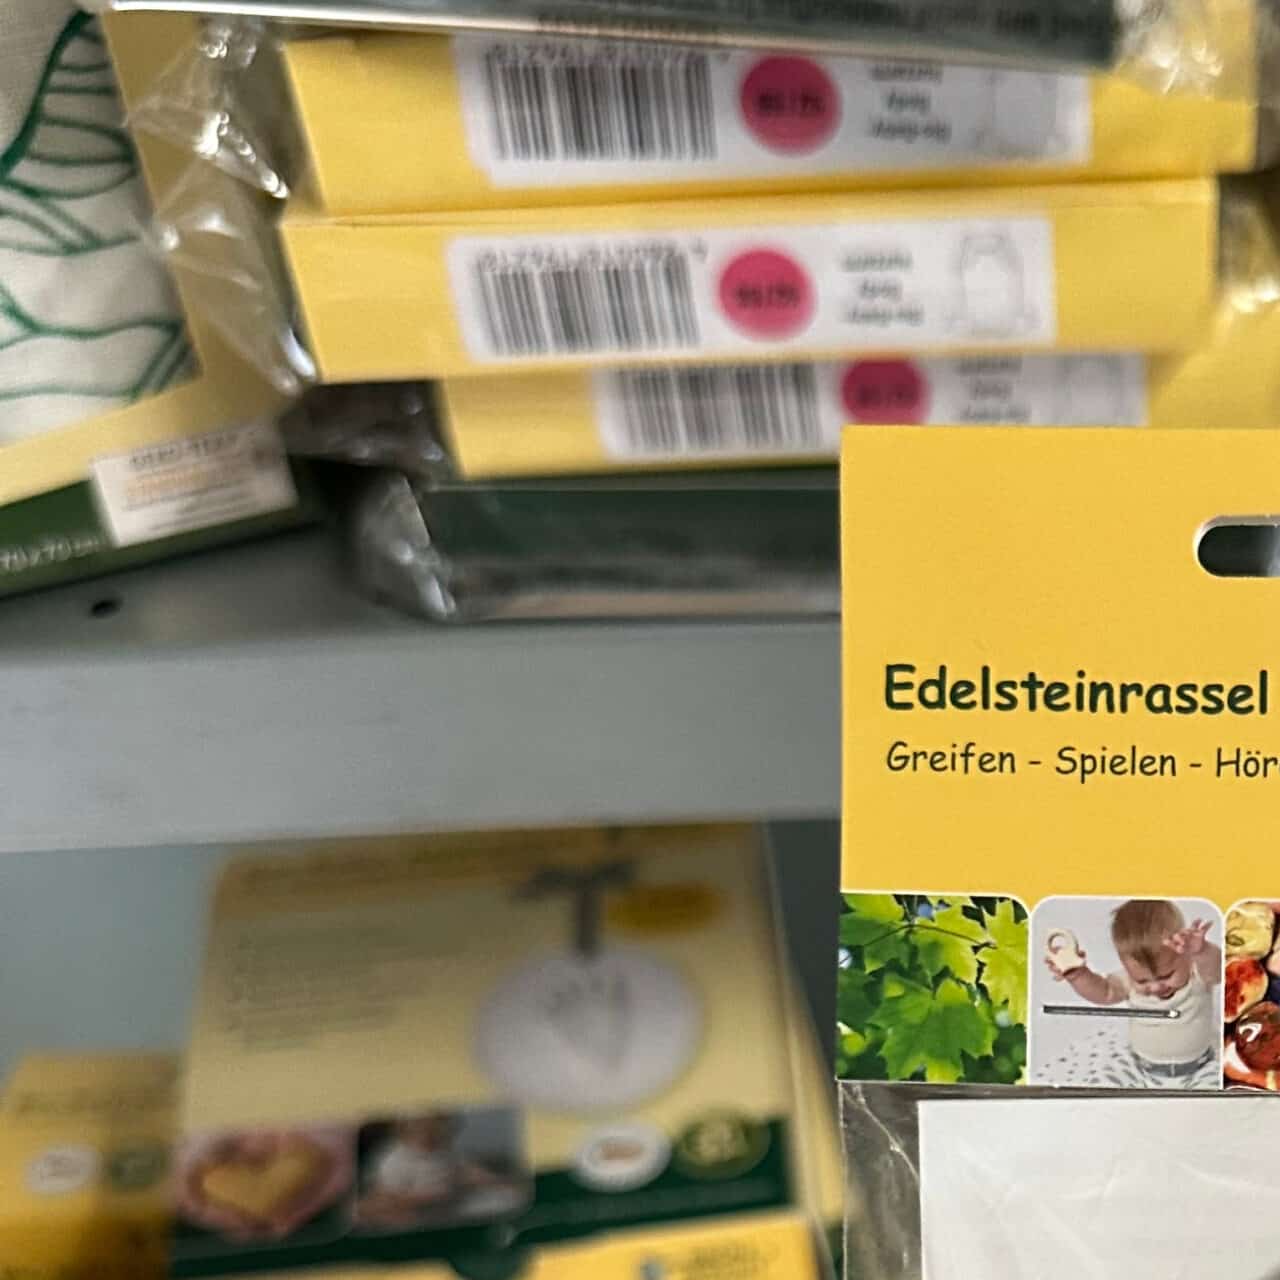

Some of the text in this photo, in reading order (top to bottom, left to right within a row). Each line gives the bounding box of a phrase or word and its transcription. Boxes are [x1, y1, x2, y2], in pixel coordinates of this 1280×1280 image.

[885, 664, 1267, 715] Edelsteinrassel
[887, 741, 1015, 774] Greifen
[1056, 745, 1176, 784] Spielen
